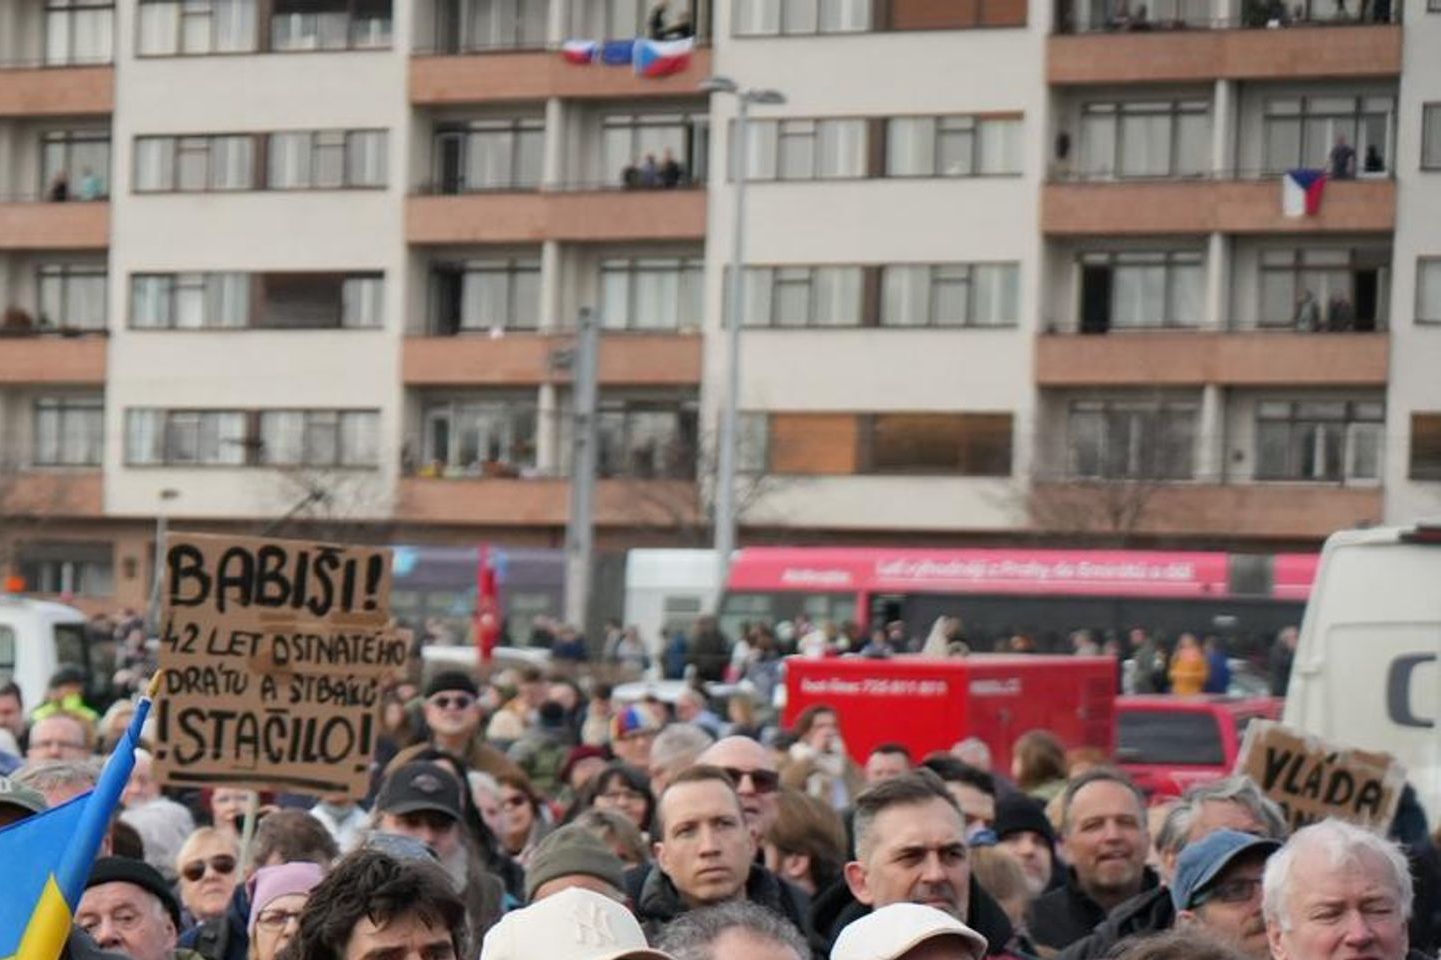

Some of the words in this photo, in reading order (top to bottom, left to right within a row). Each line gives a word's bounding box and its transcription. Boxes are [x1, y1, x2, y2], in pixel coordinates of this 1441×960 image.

[206, 627, 263, 656] LET
[272, 630, 406, 667] OSTNATÉHO
[166, 662, 249, 696] DRÁTU
[261, 674, 277, 703] A
[1262, 748, 1384, 816] VLÁDA
